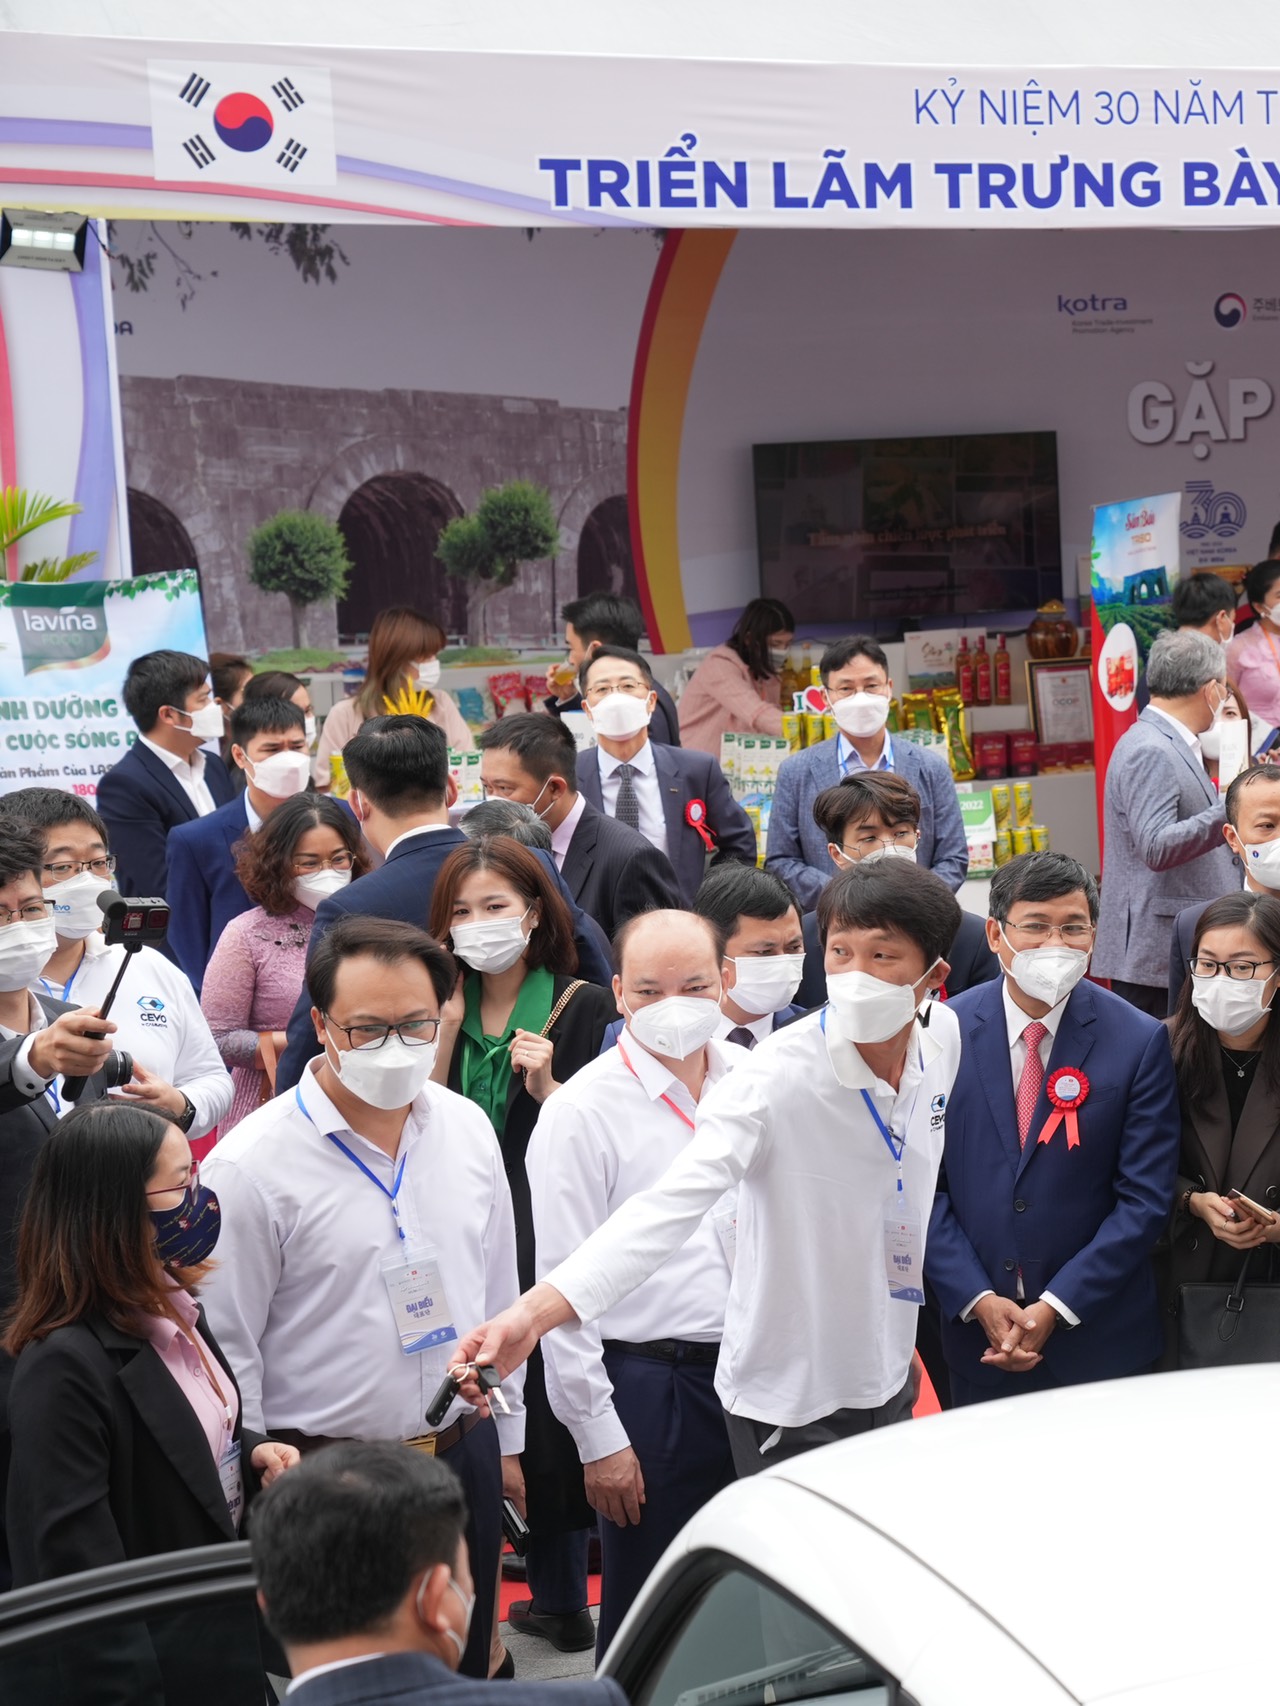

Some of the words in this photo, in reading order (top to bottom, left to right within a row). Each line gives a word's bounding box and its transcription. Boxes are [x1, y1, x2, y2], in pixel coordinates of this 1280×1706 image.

[914, 77, 965, 125] KỶ
[979, 78, 1081, 136] NIỆM
[1093, 90, 1140, 125] 30
[1153, 77, 1245, 125] NĂM
[538, 132, 750, 210] TRIỂN
[772, 148, 914, 210] LÃM
[934, 153, 1163, 210] TRƯNG
[1057, 294, 1128, 316] kotra
[1127, 360, 1273, 462] GẶP
[5, 730, 60, 755] CUỘC
[65, 725, 121, 749] SỐNG
[960, 799, 984, 811] 2022
[140, 1013, 167, 1024] CEVO
[930, 1114, 946, 1126] CEV
